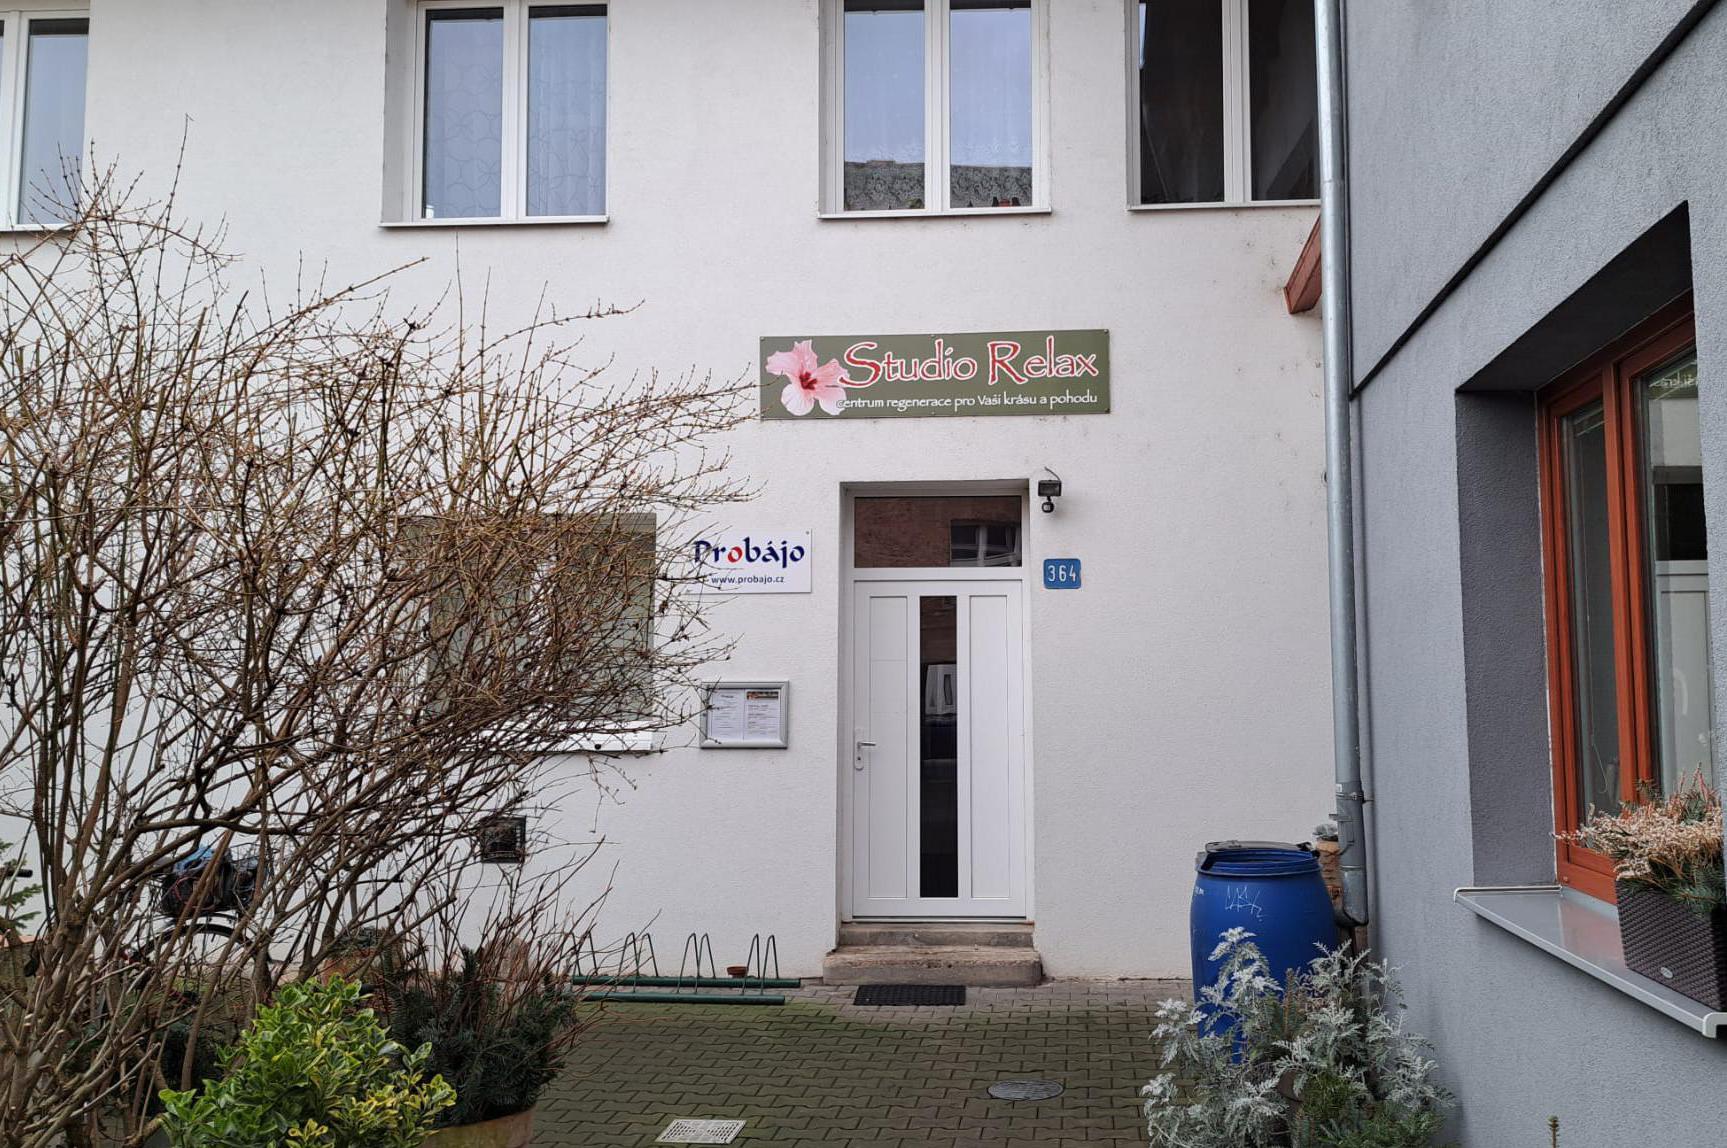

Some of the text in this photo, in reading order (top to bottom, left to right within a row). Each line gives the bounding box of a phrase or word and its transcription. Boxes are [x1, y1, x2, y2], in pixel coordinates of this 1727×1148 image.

[838, 336, 1099, 388] Studio Relax
[886, 396, 952, 411] regenerace
[954, 396, 976, 411] pro
[977, 392, 1001, 405] Vaši
[1003, 391, 1037, 405] krásu
[1039, 396, 1048, 405] a
[1050, 389, 1097, 412] pohodu
[693, 536, 805, 568] Probájo
[711, 575, 785, 585] www.probajo.cz
[1048, 564, 1077, 582] 364
